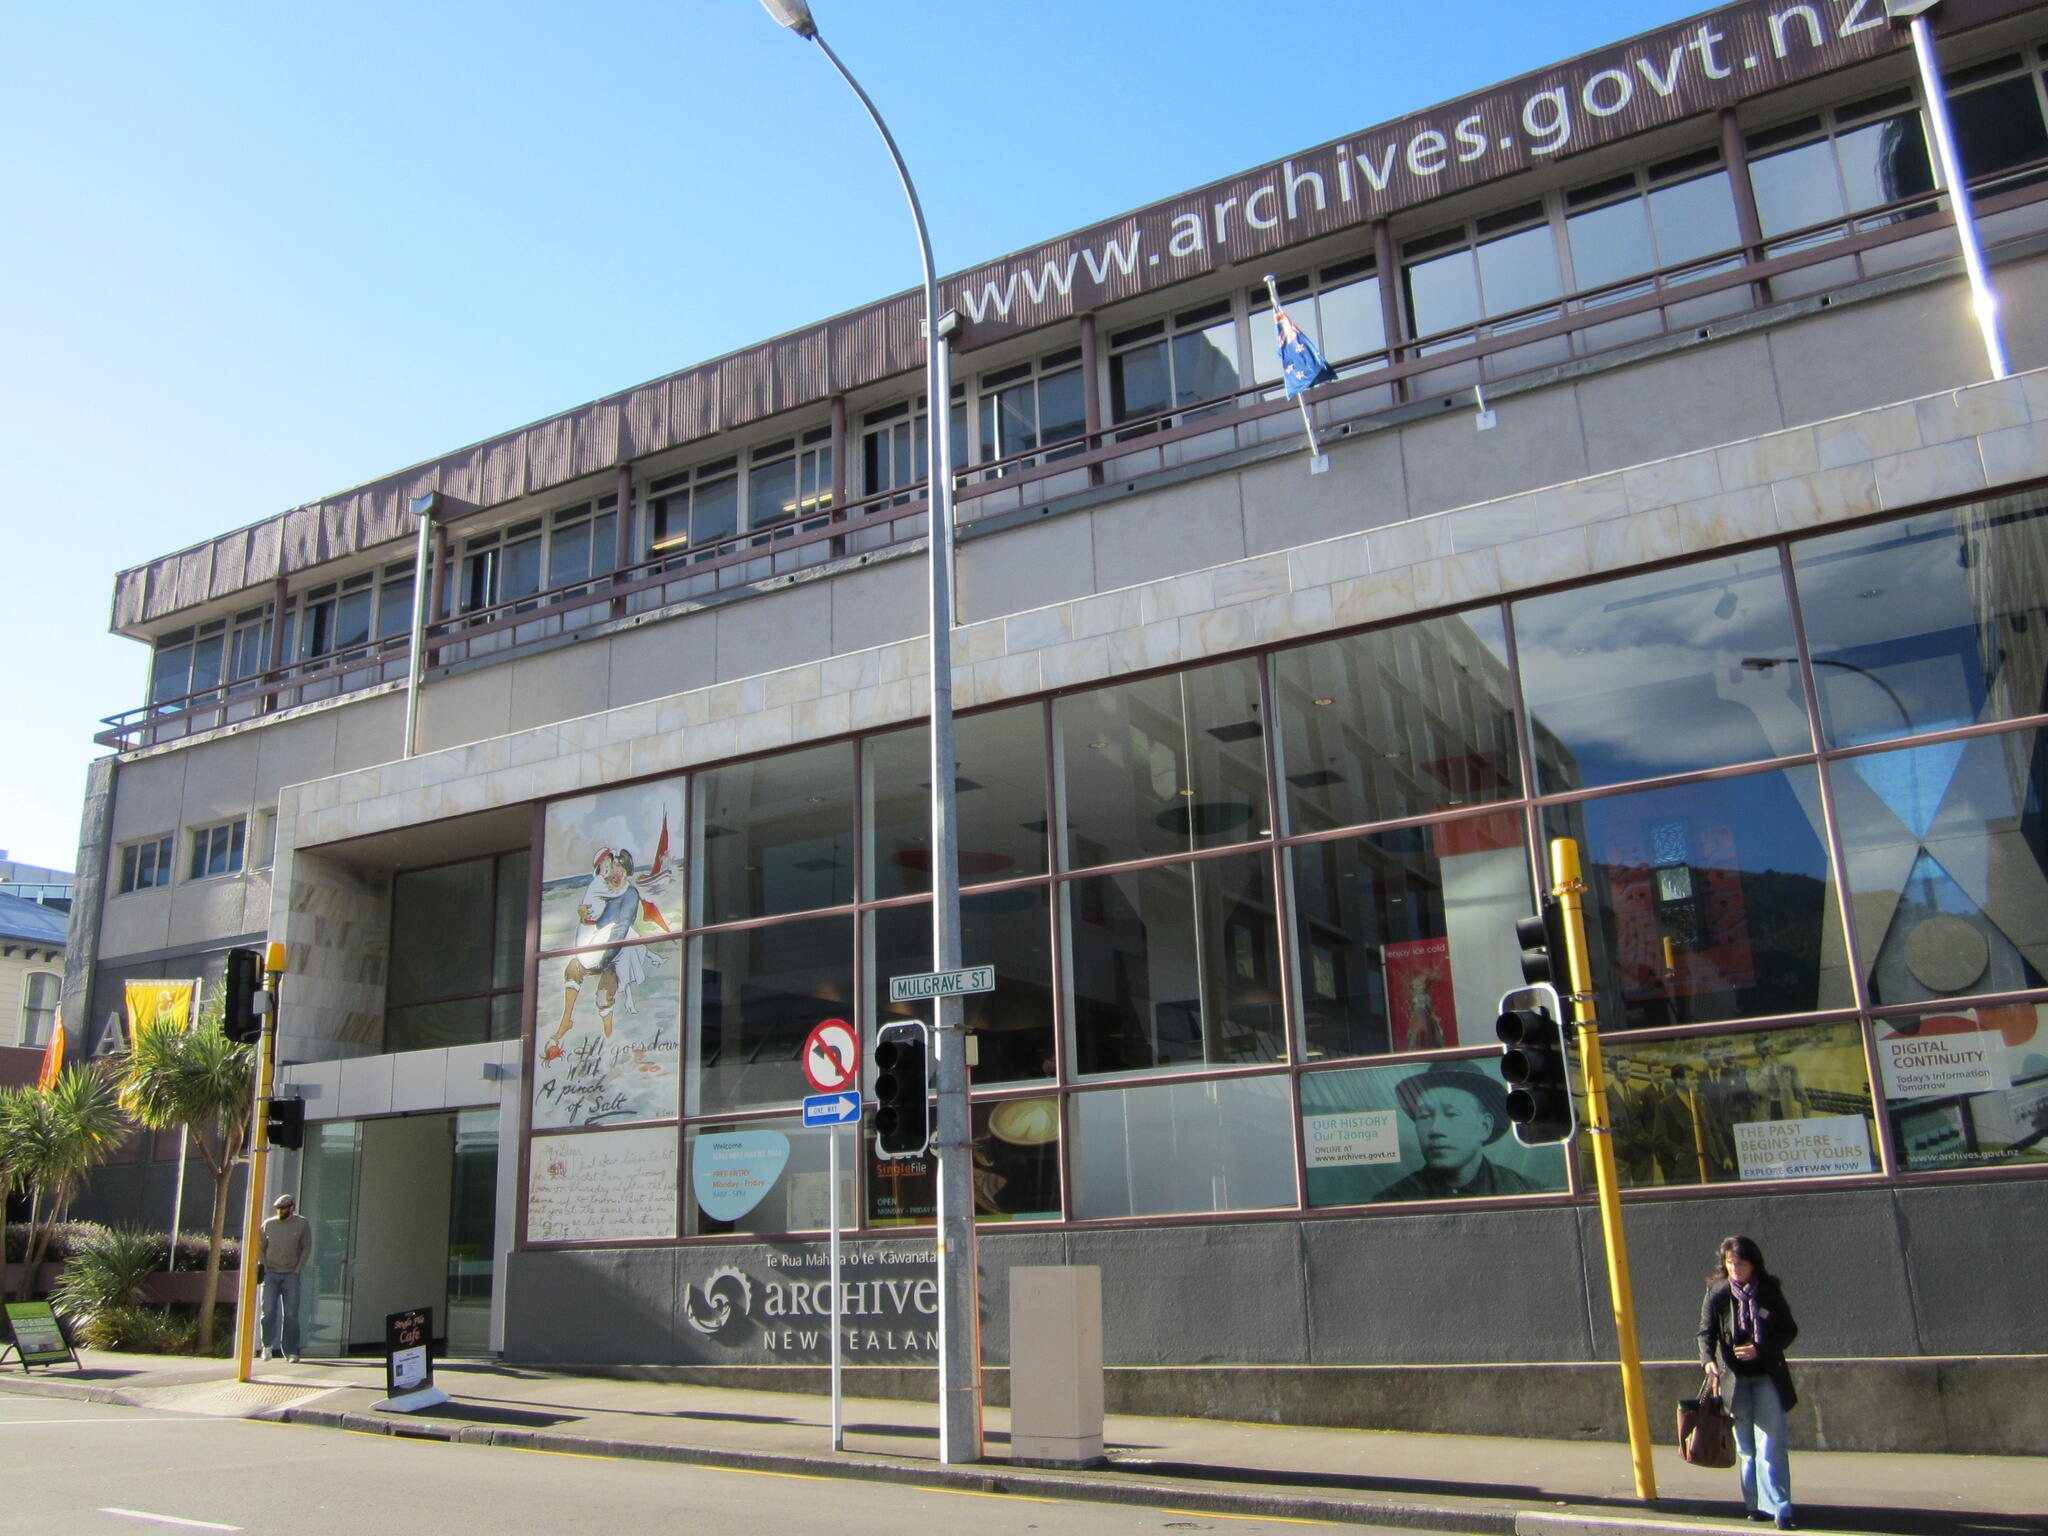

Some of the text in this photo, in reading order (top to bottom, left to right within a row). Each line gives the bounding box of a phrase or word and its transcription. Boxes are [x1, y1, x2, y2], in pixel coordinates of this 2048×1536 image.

[962, 0, 1885, 325] www.archives.govt.nz
[1412, 946, 1425, 955] ice
[1426, 943, 1446, 953] cold
[898, 971, 987, 997] MULGRAVE ST
[1891, 1041, 1949, 1056] DIGITAL
[1893, 1051, 1983, 1069] CONTINUITY
[1896, 1069, 1990, 1084] Today's Information
[555, 1074, 607, 1105] pinch
[1897, 1082, 1946, 1092] Tomorrow
[567, 1092, 628, 1124] of Salt
[813, 1107, 823, 1115] ONE
[1313, 1116, 1388, 1130] OUR HISTORY
[1313, 1130, 1378, 1142] Our Taonga
[1738, 1124, 1801, 1138] THE PAST
[713, 1143, 743, 1151] Welcome
[1314, 1146, 1340, 1154] ONLINE
[1741, 1138, 1791, 1151] BEGINS
[1795, 1135, 1831, 1147] HERE
[1314, 1151, 1396, 1163] www.archives.govt.nz
[1742, 1145, 1863, 1164] FIND OUT YOURS
[1910, 1149, 2019, 1163] www.archives.govt.nz
[1786, 1163, 1831, 1174] GATEWAY
[1835, 1162, 1859, 1171] NOW
[877, 1197, 897, 1206] OPEN
[910, 1206, 932, 1214] FRIDAY
[766, 1250, 937, 1267] Te Rua Maha o te Kāwanata
[763, 1330, 939, 1350] NEW EALAN
